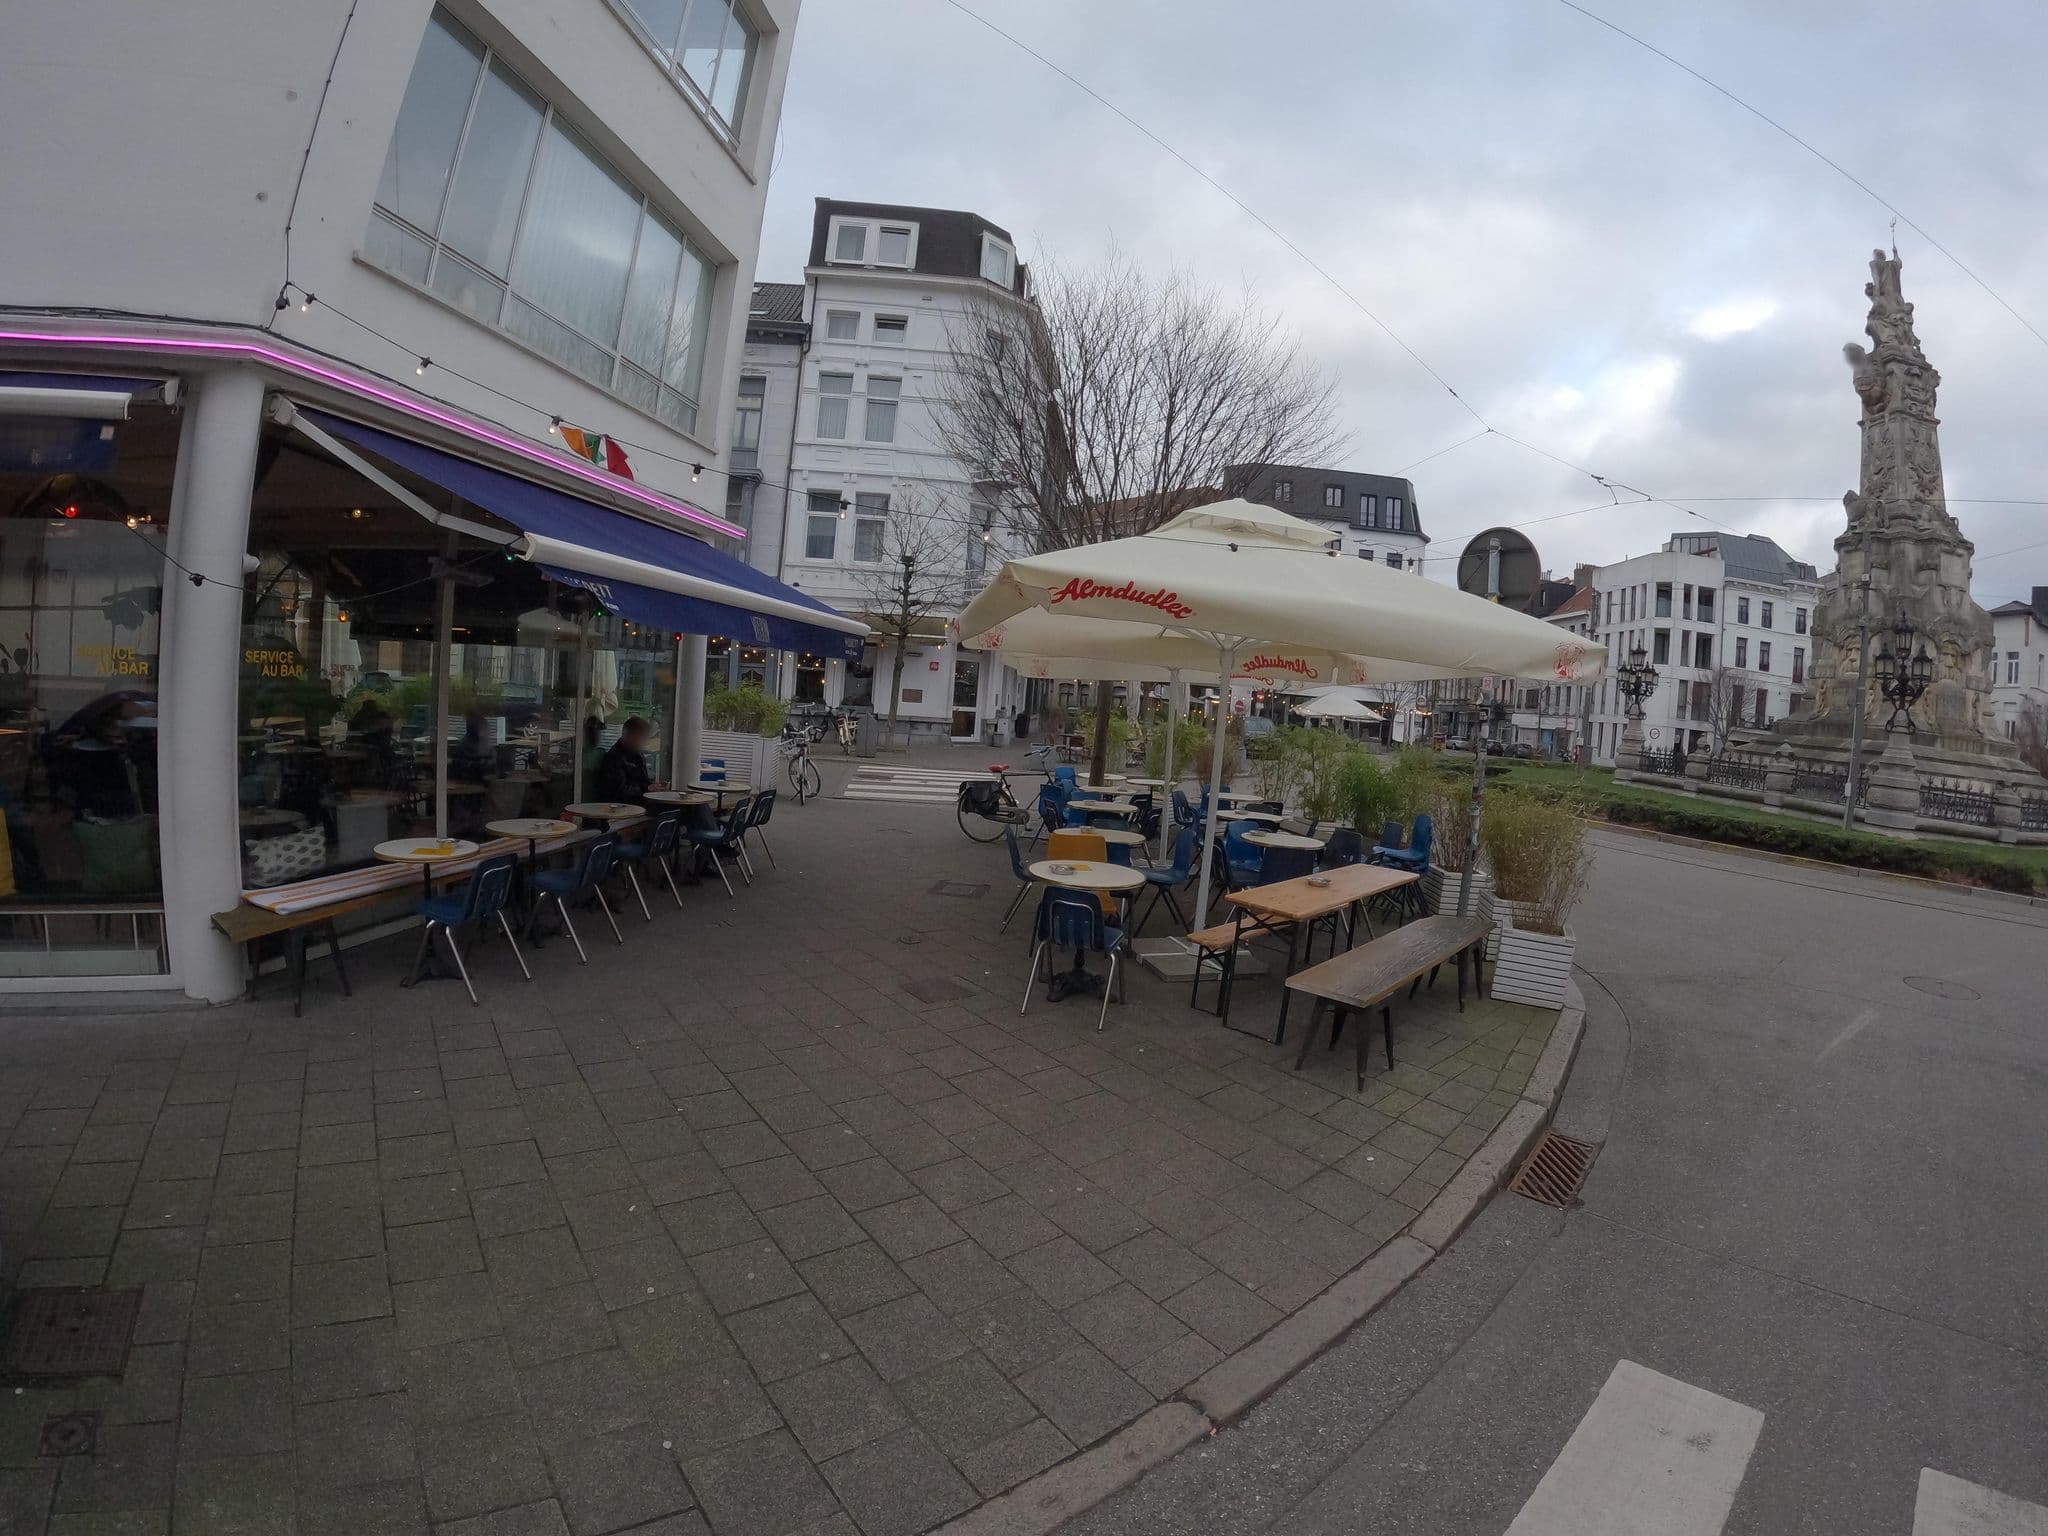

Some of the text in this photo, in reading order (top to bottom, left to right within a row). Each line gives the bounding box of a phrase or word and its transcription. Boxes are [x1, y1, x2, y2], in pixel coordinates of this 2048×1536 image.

[1048, 577, 1193, 619] Almdudler
[76, 646, 136, 660] VICE
[245, 650, 294, 664] SERVICE
[119, 661, 149, 675] BAR
[262, 664, 304, 677] AU BAR
